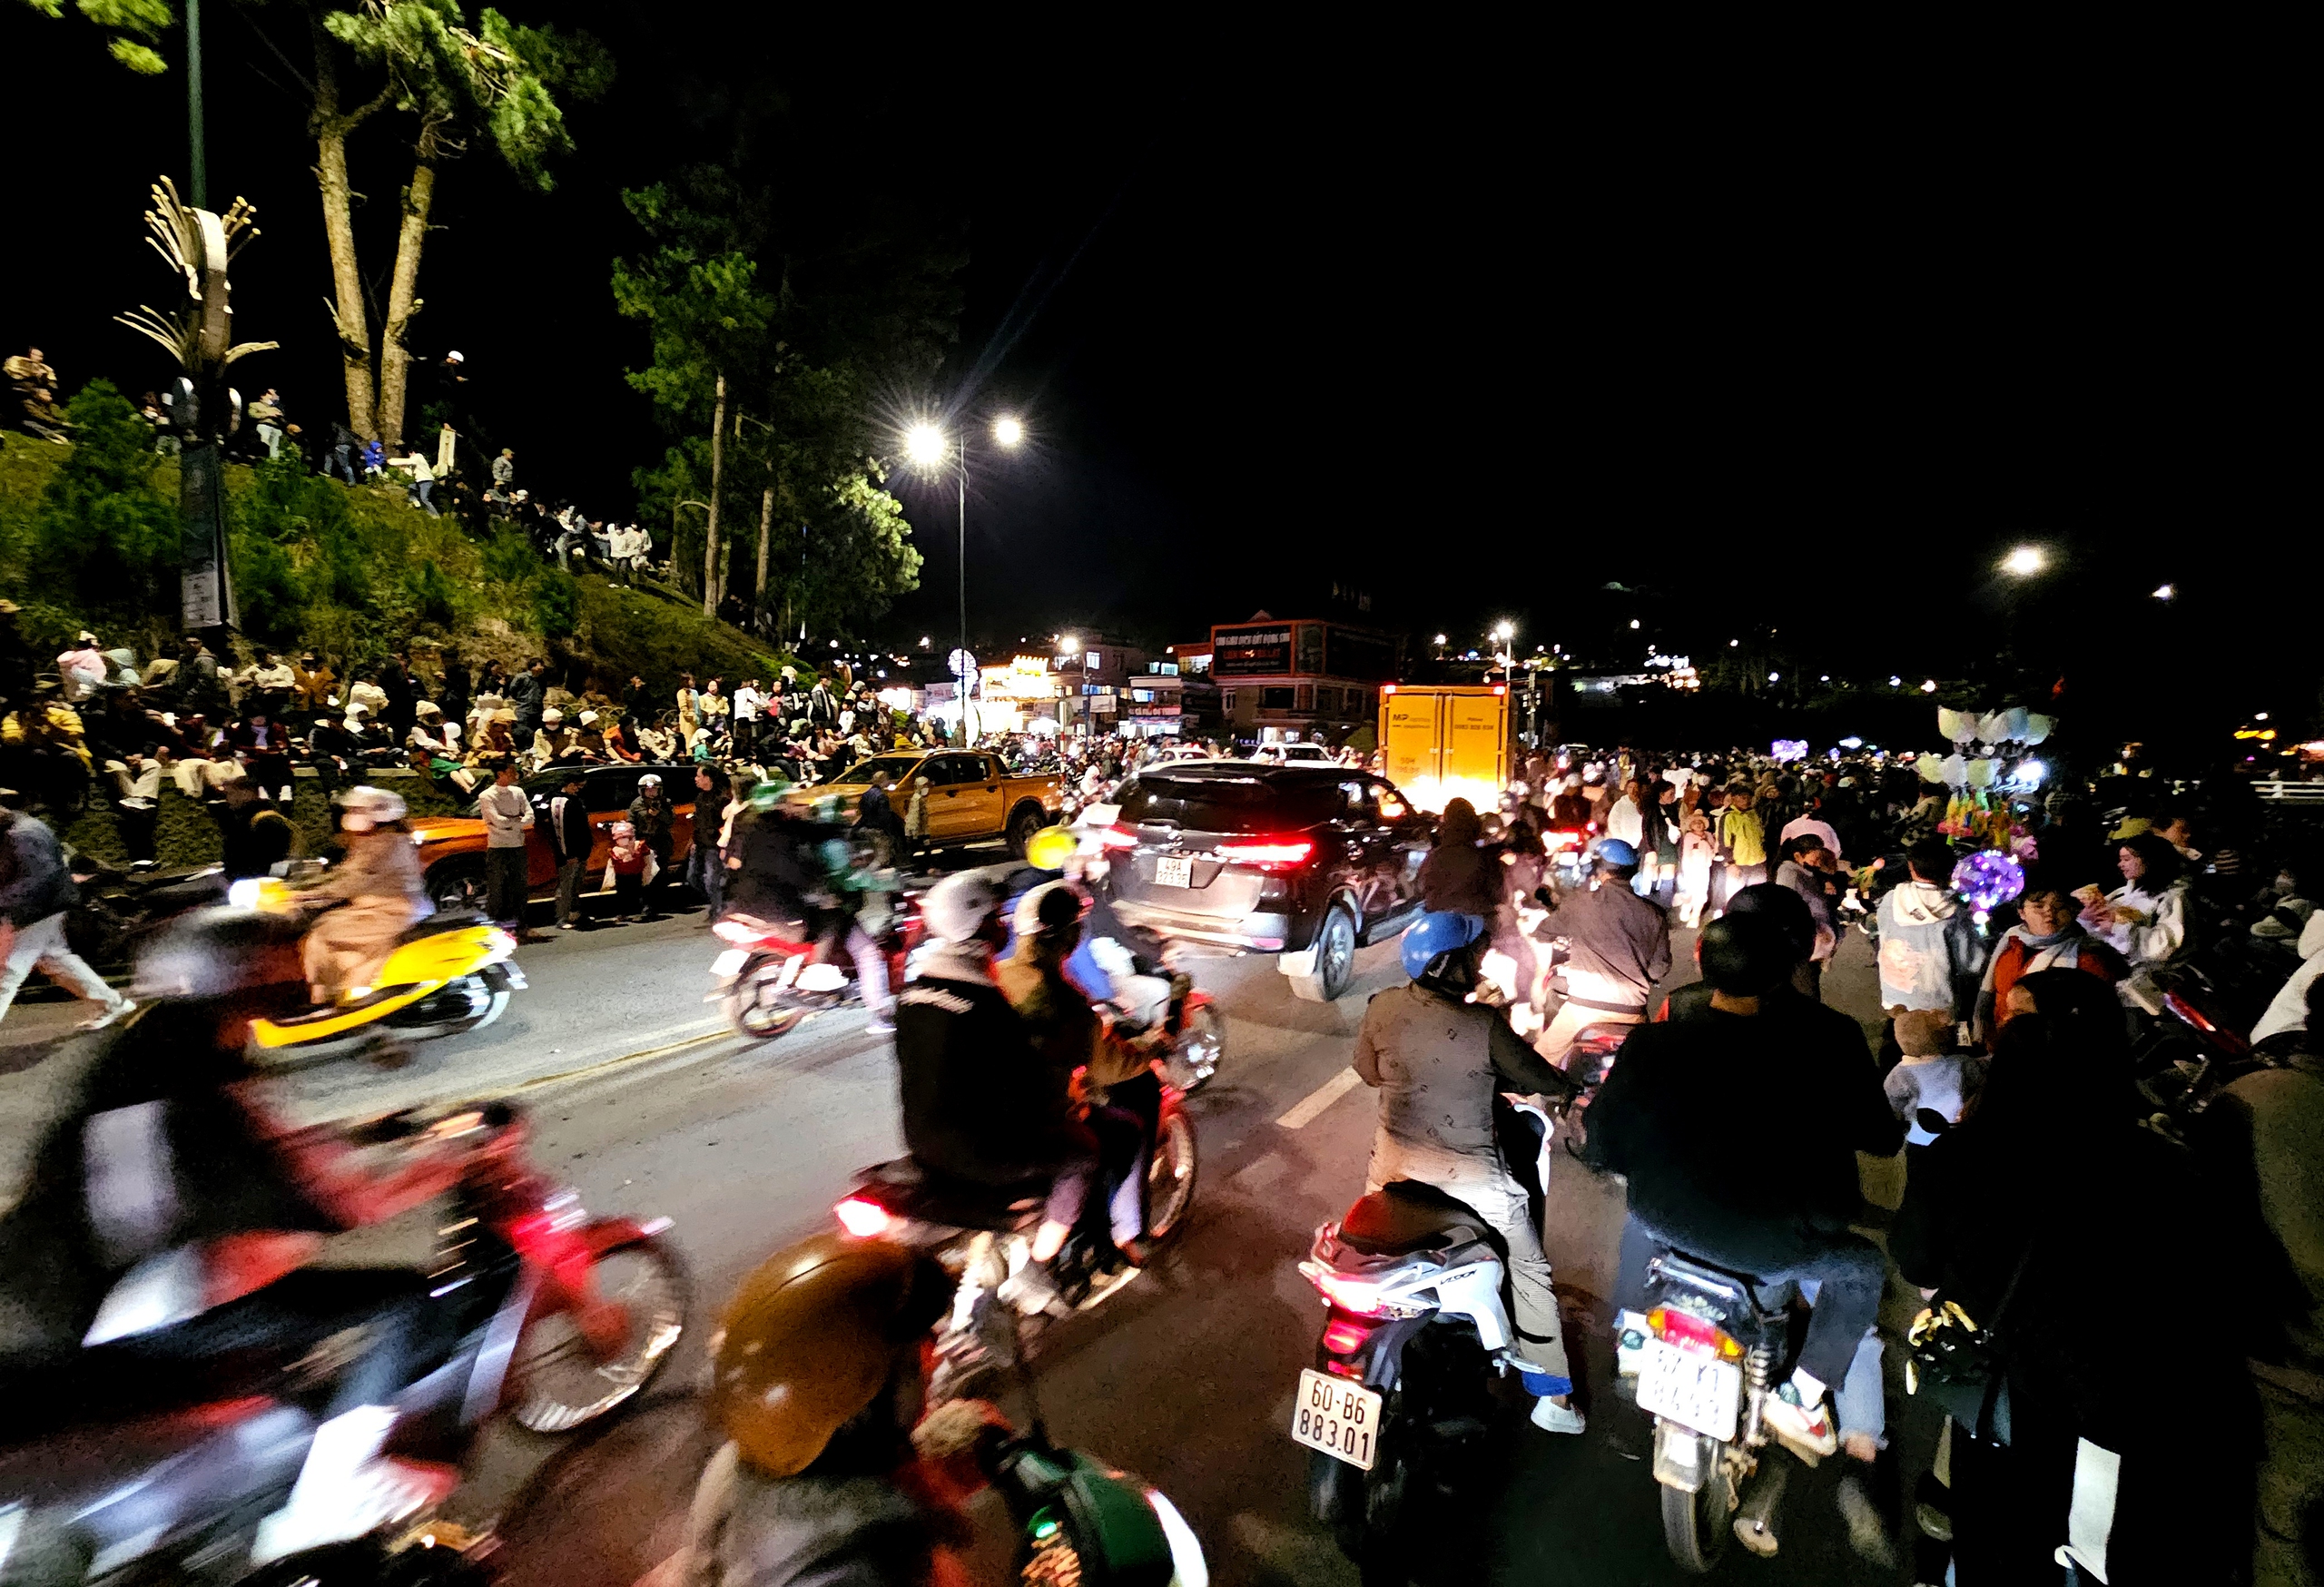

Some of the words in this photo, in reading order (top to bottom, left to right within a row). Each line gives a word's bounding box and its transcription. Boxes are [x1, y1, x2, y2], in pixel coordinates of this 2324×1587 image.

[1157, 871, 1187, 885] 32335
[1165, 860, 1181, 872] 49A
[1311, 1379, 1366, 1424] 60-B6
[1299, 1408, 1370, 1462] 883.01
